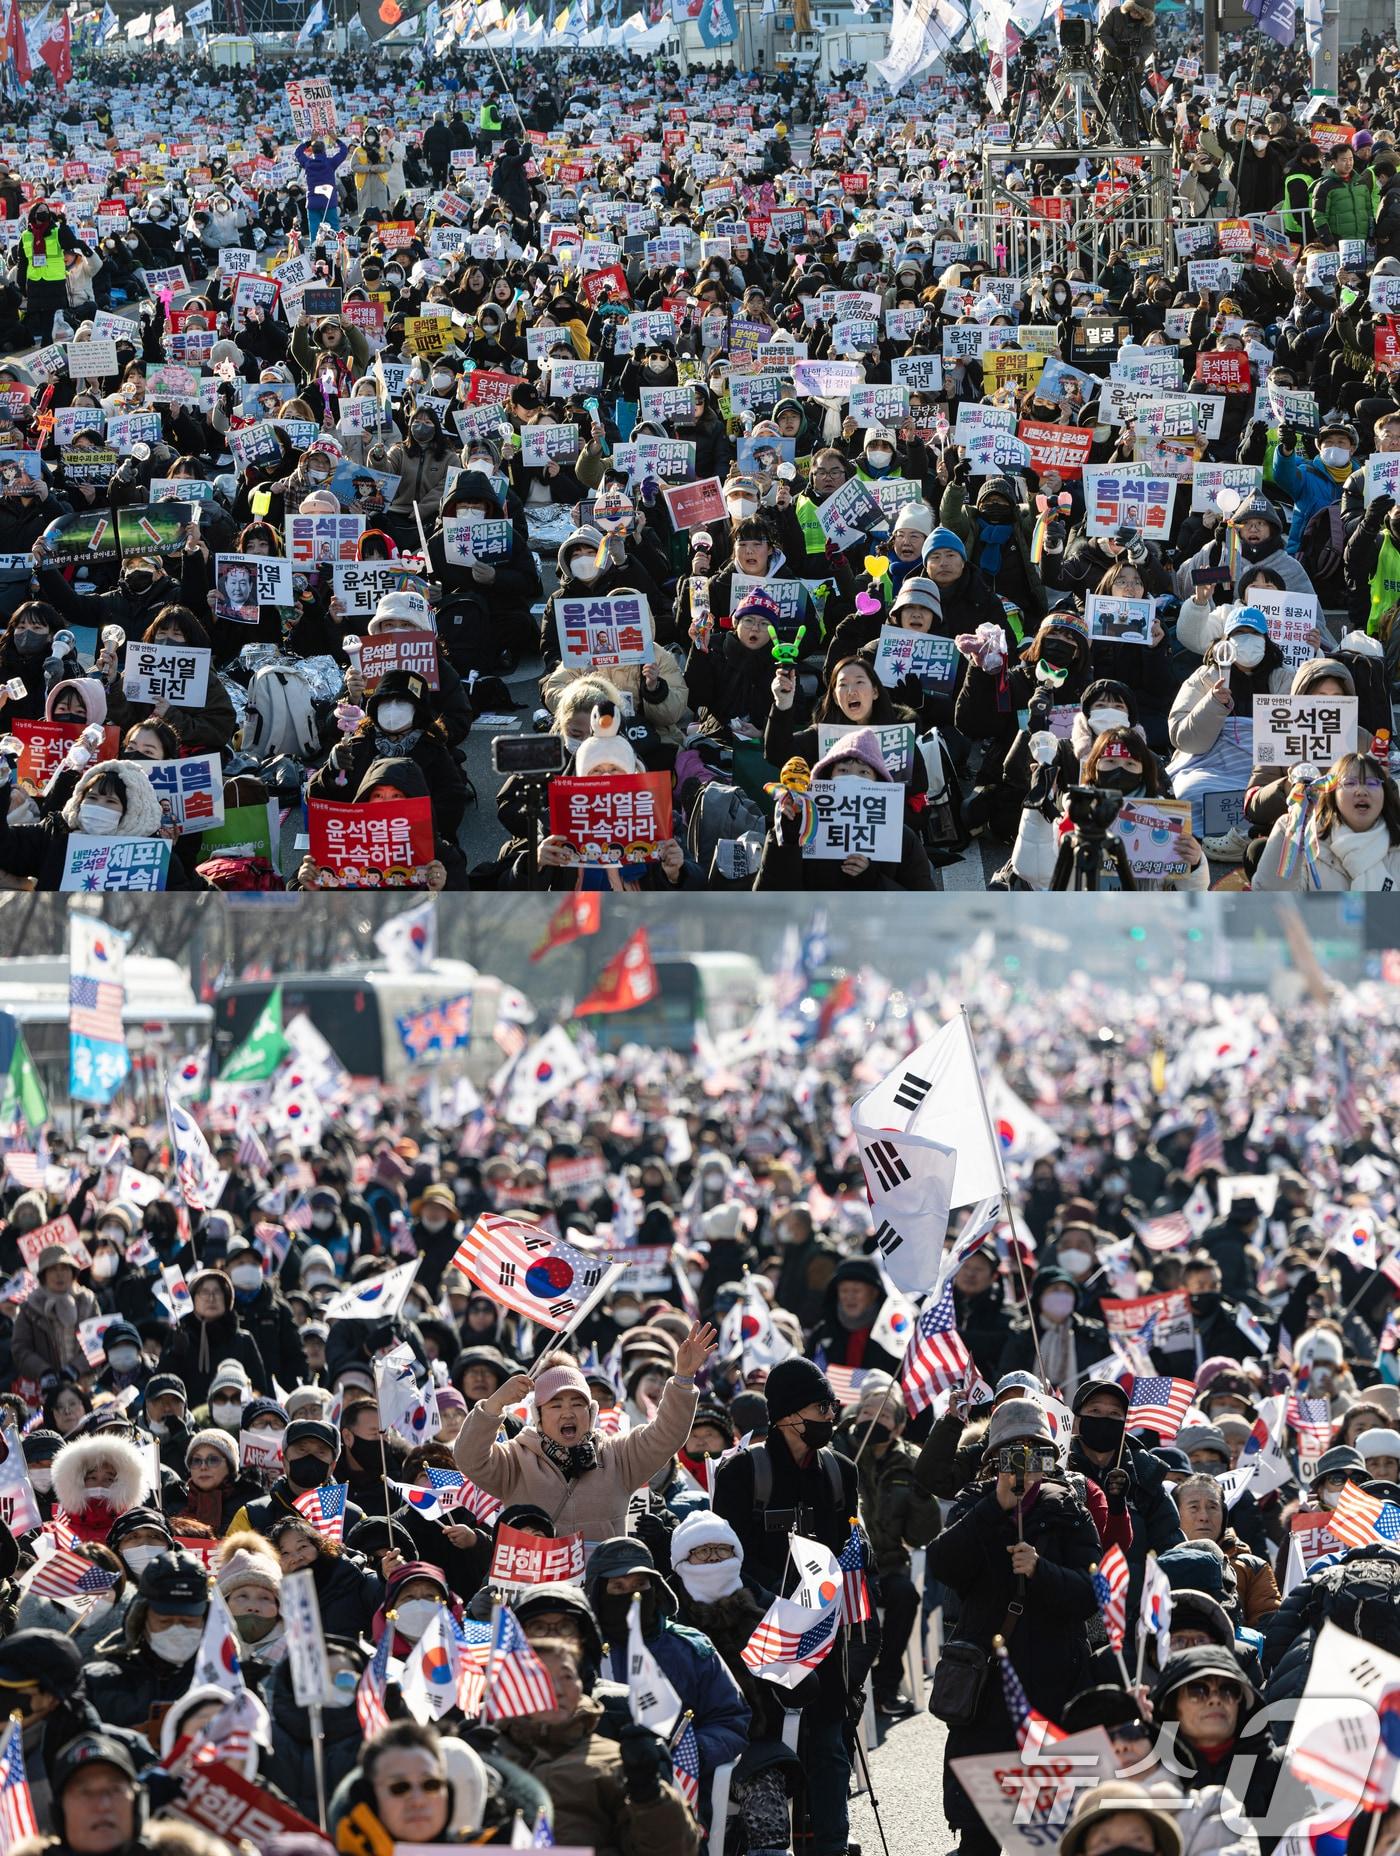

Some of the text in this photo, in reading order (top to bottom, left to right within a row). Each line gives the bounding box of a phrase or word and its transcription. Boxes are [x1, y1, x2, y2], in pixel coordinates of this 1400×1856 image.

[304, 86, 332, 101] 하지마
[436, 232, 462, 242] 윤석열
[441, 240, 459, 251] 퇴진
[224, 251, 251, 264] 윤석열
[229, 260, 248, 271] 퇴진
[278, 261, 305, 279] 윤석열
[286, 270, 305, 286] 퇴진
[986, 283, 1014, 293] 윤석열
[345, 307, 376, 318] 윤석열을
[648, 313, 673, 326] 체포!
[412, 316, 439, 330] 윤석열
[851, 322, 873, 333] 체포!
[649, 326, 672, 337] 구속!
[851, 332, 873, 344] 구속!
[950, 328, 982, 345] 윤석열
[1085, 328, 1114, 344] 멸공
[172, 334, 214, 348] 윤석열
[414, 334, 442, 351] 파면
[956, 342, 978, 356] 퇴진
[995, 353, 1029, 368] 윤석열
[1202, 360, 1239, 372] 윤석열을
[574, 364, 600, 376] 체포!
[898, 362, 934, 376] 윤석열
[1151, 361, 1179, 378] 체포!
[1202, 370, 1240, 382] 구속하라
[574, 376, 598, 390] 구속!
[750, 378, 777, 392] 체포!
[905, 376, 929, 388] 퇴진
[663, 389, 691, 404] 체포!
[751, 391, 777, 406] 구속!
[875, 388, 903, 403] 해체
[664, 404, 691, 418] 구속!
[874, 404, 903, 419] 하라
[1164, 403, 1192, 420] 즉각
[1284, 397, 1314, 414] 체포!
[75, 410, 100, 421] 체포!
[474, 405, 501, 422] 체포!
[984, 411, 1011, 427] 해체
[1285, 412, 1314, 428] 구속!
[129, 416, 157, 429] 체포!
[286, 423, 314, 437] 체포!
[1164, 420, 1194, 437] 파면
[130, 429, 157, 441] 구속!
[241, 425, 269, 442] 체포!
[545, 427, 573, 442] 체포!
[1023, 428, 1089, 444] 내란수괴 윤석열
[248, 442, 274, 458] 구속!
[546, 442, 574, 457] 구속!
[658, 443, 688, 460] 해체
[995, 435, 1025, 453] 해체
[994, 452, 1026, 465] 하라
[657, 461, 688, 476] 하라
[1224, 466, 1256, 488] 해체
[177, 485, 206, 499] 즉각
[1097, 480, 1169, 504] 윤석열
[293, 518, 359, 539] 윤석열
[448, 526, 470, 534] 내란수괴
[472, 522, 506, 541] 체포!
[448, 533, 470, 542] 윤석열
[473, 541, 506, 557] 구속!
[343, 571, 396, 590] 윤석열
[765, 582, 799, 600] 해체
[563, 600, 640, 629] 윤석열
[1284, 606, 1312, 619] 침공시
[1285, 620, 1312, 631] 유도한
[884, 638, 913, 647] 내란수괴
[913, 639, 953, 661] 체포!
[1292, 644, 1310, 656] 잡아
[362, 642, 433, 660] 윤석열 OUT!
[882, 646, 911, 657] 윤석열
[138, 654, 194, 678] 윤석열
[401, 658, 435, 673] OUT!
[904, 661, 949, 680] 구속!
[148, 678, 185, 700] 퇴진
[1256, 697, 1292, 706] 긴말 안한다
[1269, 708, 1341, 733] 윤석열
[1285, 736, 1332, 761] 퇴진
[569, 792, 655, 818] 윤석열을
[814, 795, 887, 824] 윤석열
[326, 818, 411, 842] 윤석열을
[569, 818, 656, 842] 구속하라
[826, 825, 875, 853] 퇴진
[73, 848, 110, 859] 내란수괴
[110, 842, 164, 866] 체포!
[328, 843, 414, 866] 구속하라
[71, 859, 106, 872] 윤석열
[1133, 862, 1186, 873] 윤석열 파면!
[107, 871, 159, 891] 구속!
[26, 1224, 66, 1254] STOP
[1299, 1528, 1348, 1559] 탄핵
[493, 1539, 584, 1582] 탄핵 무효
